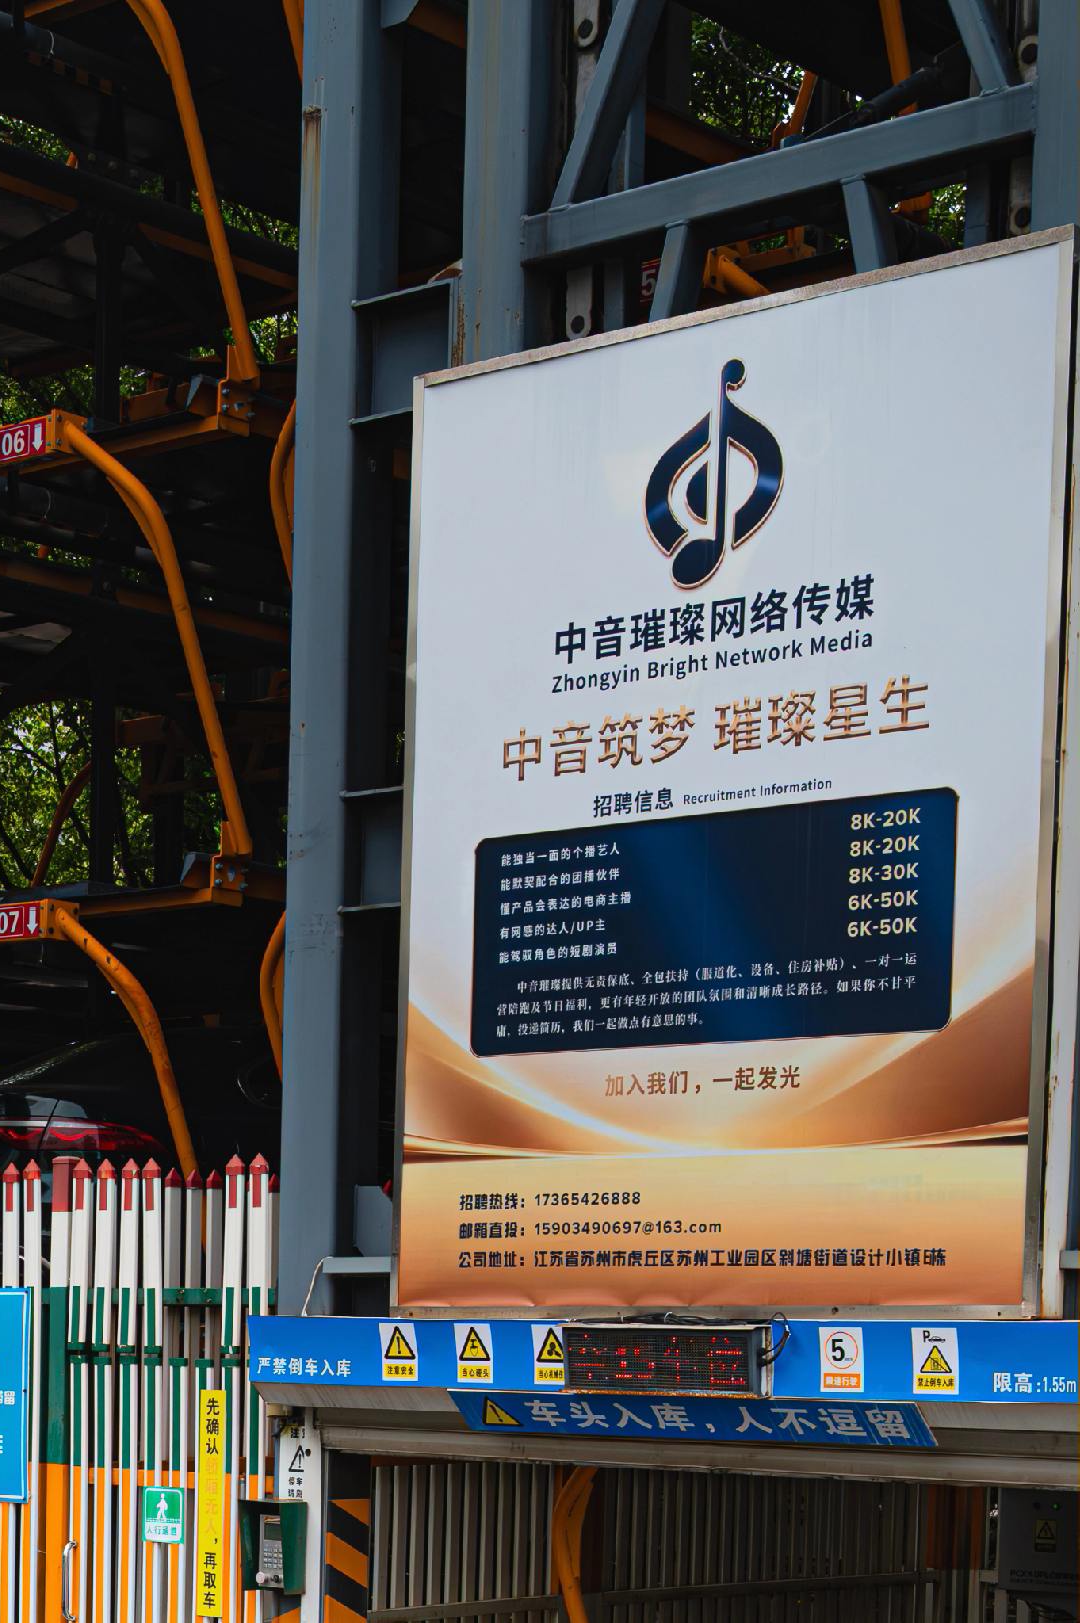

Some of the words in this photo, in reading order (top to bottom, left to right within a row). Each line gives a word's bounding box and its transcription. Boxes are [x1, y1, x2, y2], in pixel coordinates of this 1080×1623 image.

[0, 428, 25, 457] 06
[554, 574, 875, 665] 中音璀璨网络传媒
[551, 662, 641, 694] Zhongyin
[648, 651, 709, 681] Bright
[715, 640, 803, 671] Network
[810, 629, 873, 656] Media
[502, 705, 696, 781] 中音筑梦
[713, 674, 930, 754] 璀璨星生
[593, 787, 674, 819] 招聘信息
[683, 785, 756, 806] Recruitment
[760, 777, 832, 798] Information
[850, 808, 921, 830] 8K-20K
[501, 842, 620, 867] 能独当一面的个播艺人
[849, 835, 920, 857] 8K-20K
[500, 868, 620, 891] 能默契配合的团播伙伴
[848, 862, 919, 884] 8K-30K
[500, 891, 632, 916] 懂产品会表达的电商主播
[848, 890, 919, 911] 6K-50K
[499, 918, 606, 940] 有网感的达人/UP主
[847, 917, 918, 937] 6K-50K
[499, 942, 617, 964] 能驾驭角色的短剧演员
[605, 1065, 801, 1097] 加入我们，一起发光
[831, 1338, 846, 1362] 5
[256, 1357, 352, 1378] 严禁倒车入库
[387, 1365, 414, 1376] 注意安全
[993, 1371, 1077, 1394] 限高:1.55m
[524, 1399, 911, 1440] 车头入库，人不逗留
